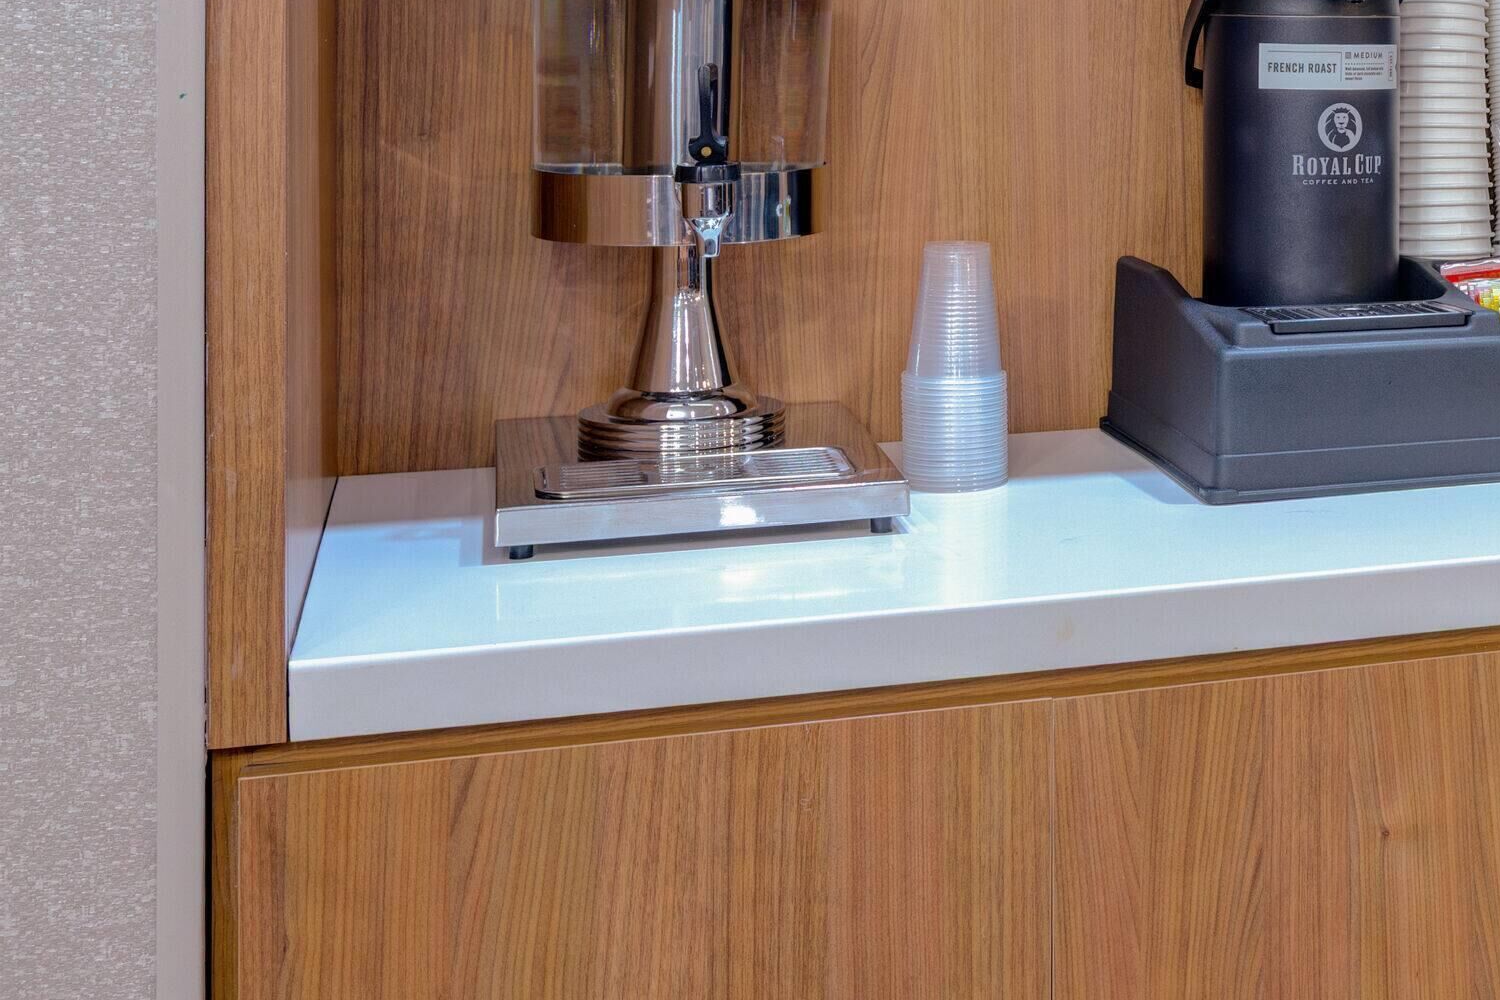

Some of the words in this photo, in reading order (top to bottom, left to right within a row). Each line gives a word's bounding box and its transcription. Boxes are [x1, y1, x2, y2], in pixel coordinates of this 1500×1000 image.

[1267, 62, 1305, 74] FRENCH
[1308, 62, 1337, 74] ROAST
[1292, 154, 1352, 176] ROYAL
[1355, 153, 1382, 174] CUP
